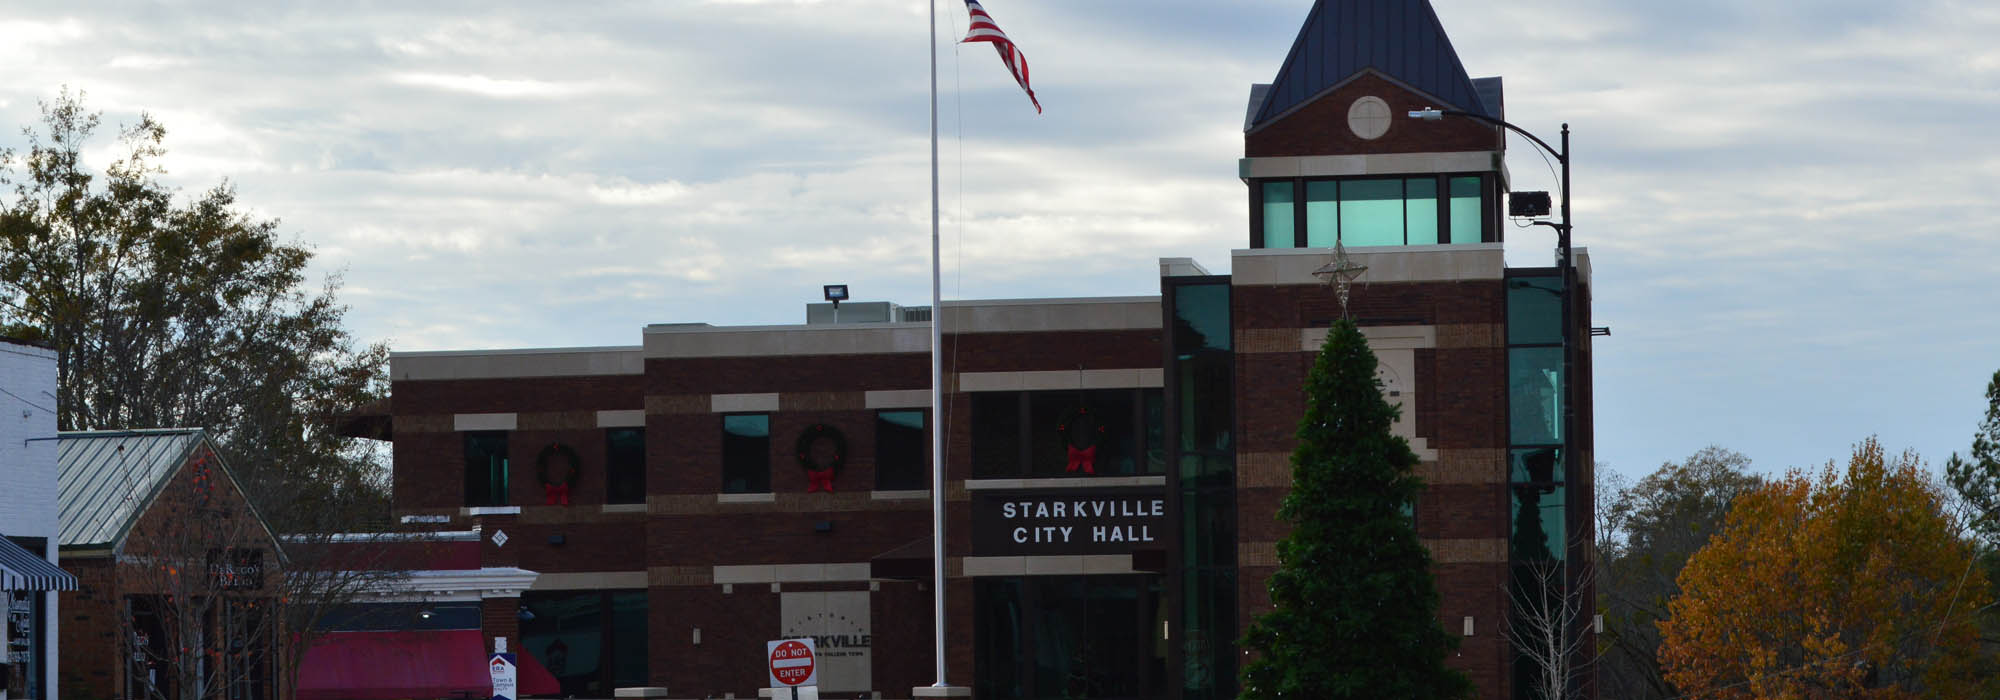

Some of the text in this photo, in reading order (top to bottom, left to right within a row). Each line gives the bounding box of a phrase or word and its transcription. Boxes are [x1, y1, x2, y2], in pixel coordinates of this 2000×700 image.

[1003, 500, 1164, 518] STARKVILLE
[1013, 525, 1154, 543] CITY HALL
[775, 650, 787, 658] DO
[791, 648, 807, 657] NOT
[780, 669, 806, 678] ENTER
